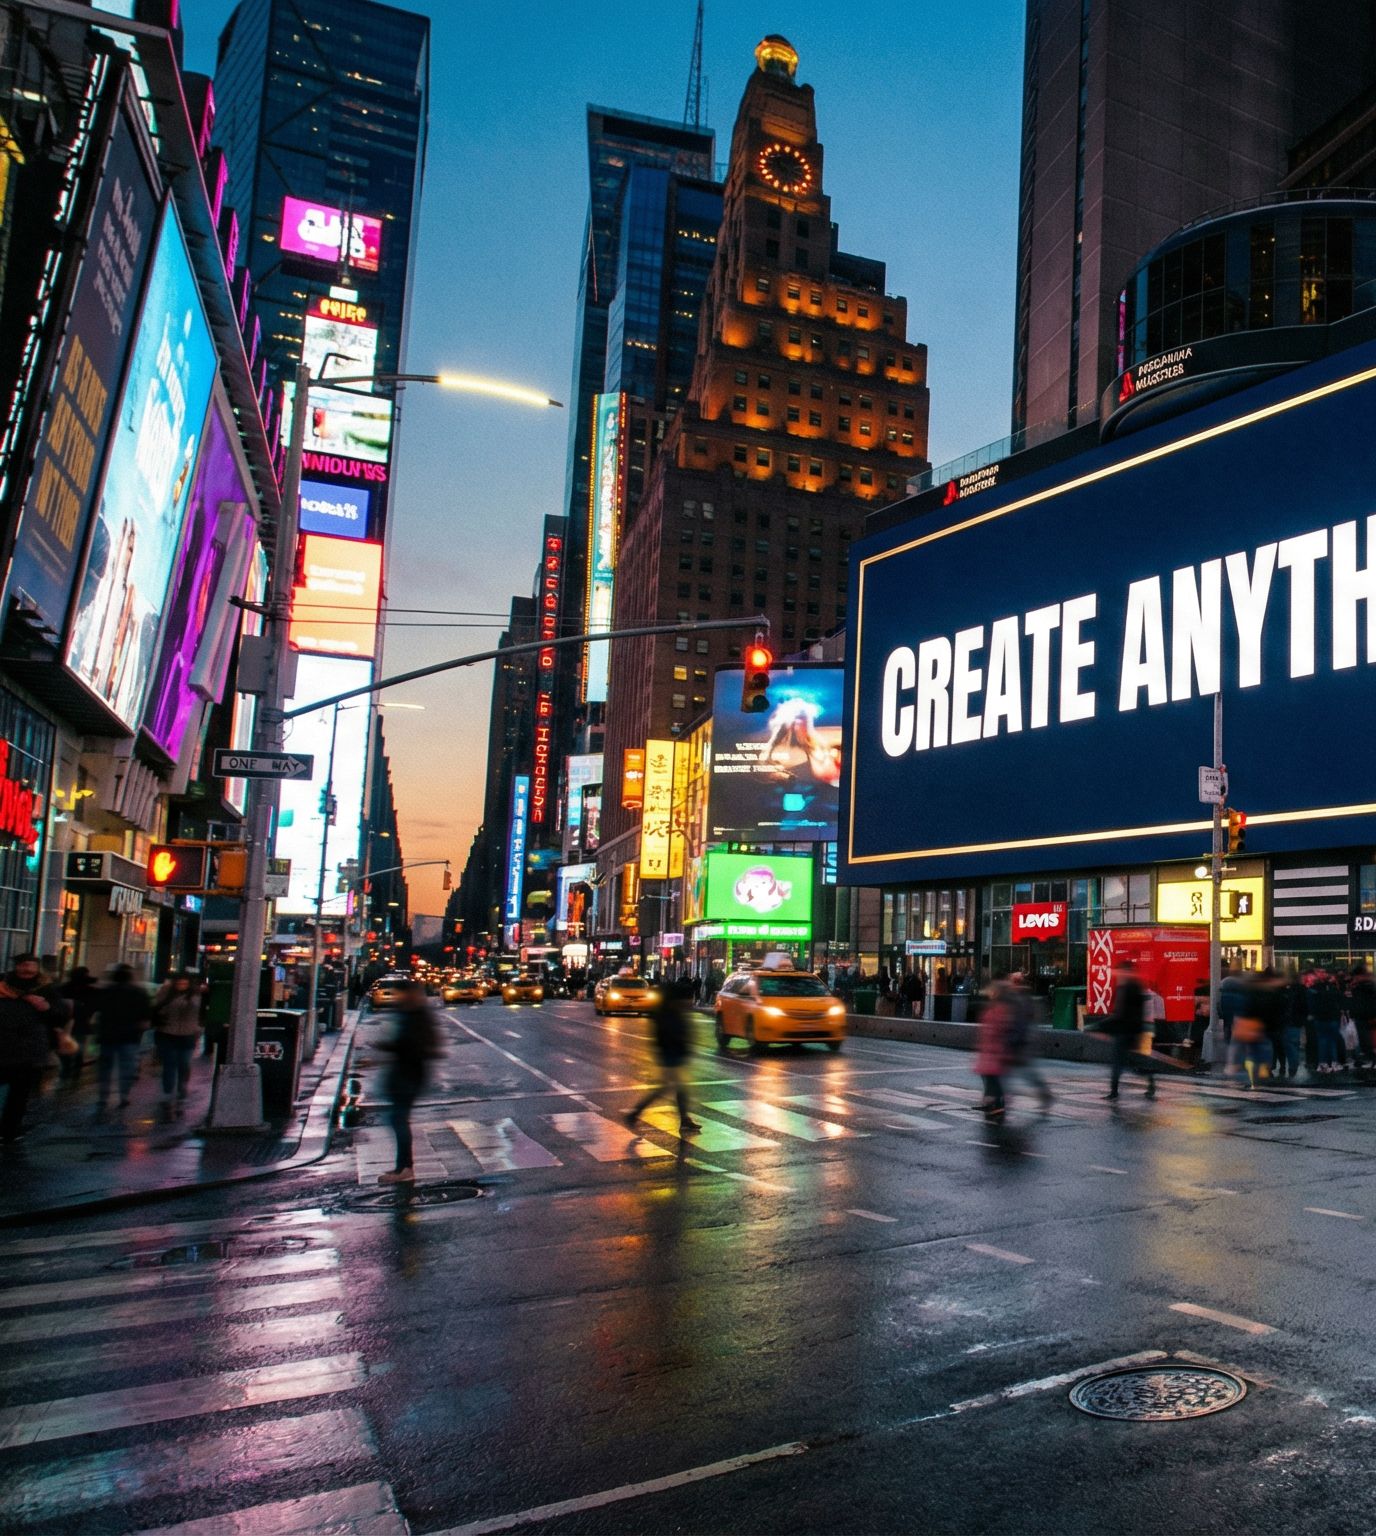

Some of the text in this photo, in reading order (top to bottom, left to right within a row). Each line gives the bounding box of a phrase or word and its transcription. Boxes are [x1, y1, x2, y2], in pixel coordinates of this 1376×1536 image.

[881, 593, 1097, 757] CREATE
[229, 757, 299, 772] ONE WAY
